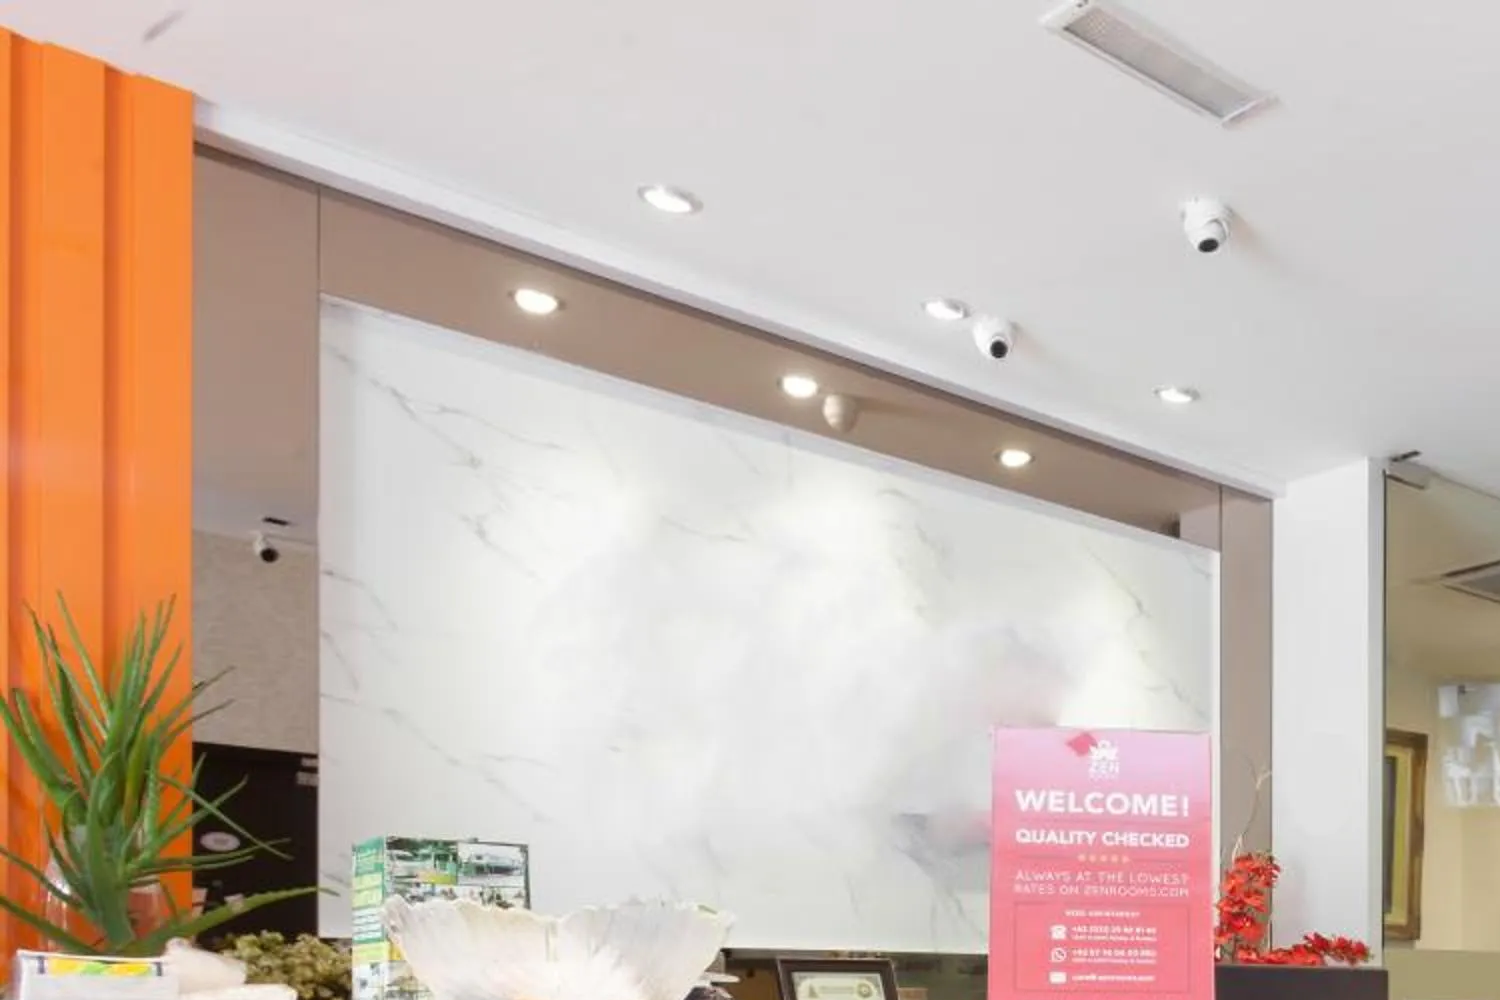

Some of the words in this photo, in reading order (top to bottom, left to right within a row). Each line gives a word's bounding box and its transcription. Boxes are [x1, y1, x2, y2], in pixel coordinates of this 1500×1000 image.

[1015, 789, 1190, 818] WELCOME!
[1015, 828, 1097, 846] QUALITY
[1102, 831, 1190, 848] CHECKED
[1015, 870, 1071, 882] ALWAYS
[1076, 872, 1092, 882] AT
[1098, 872, 1125, 884] THE
[1129, 873, 1190, 886] LOWEST
[1014, 883, 1056, 895] RATES
[1059, 884, 1080, 896] ON
